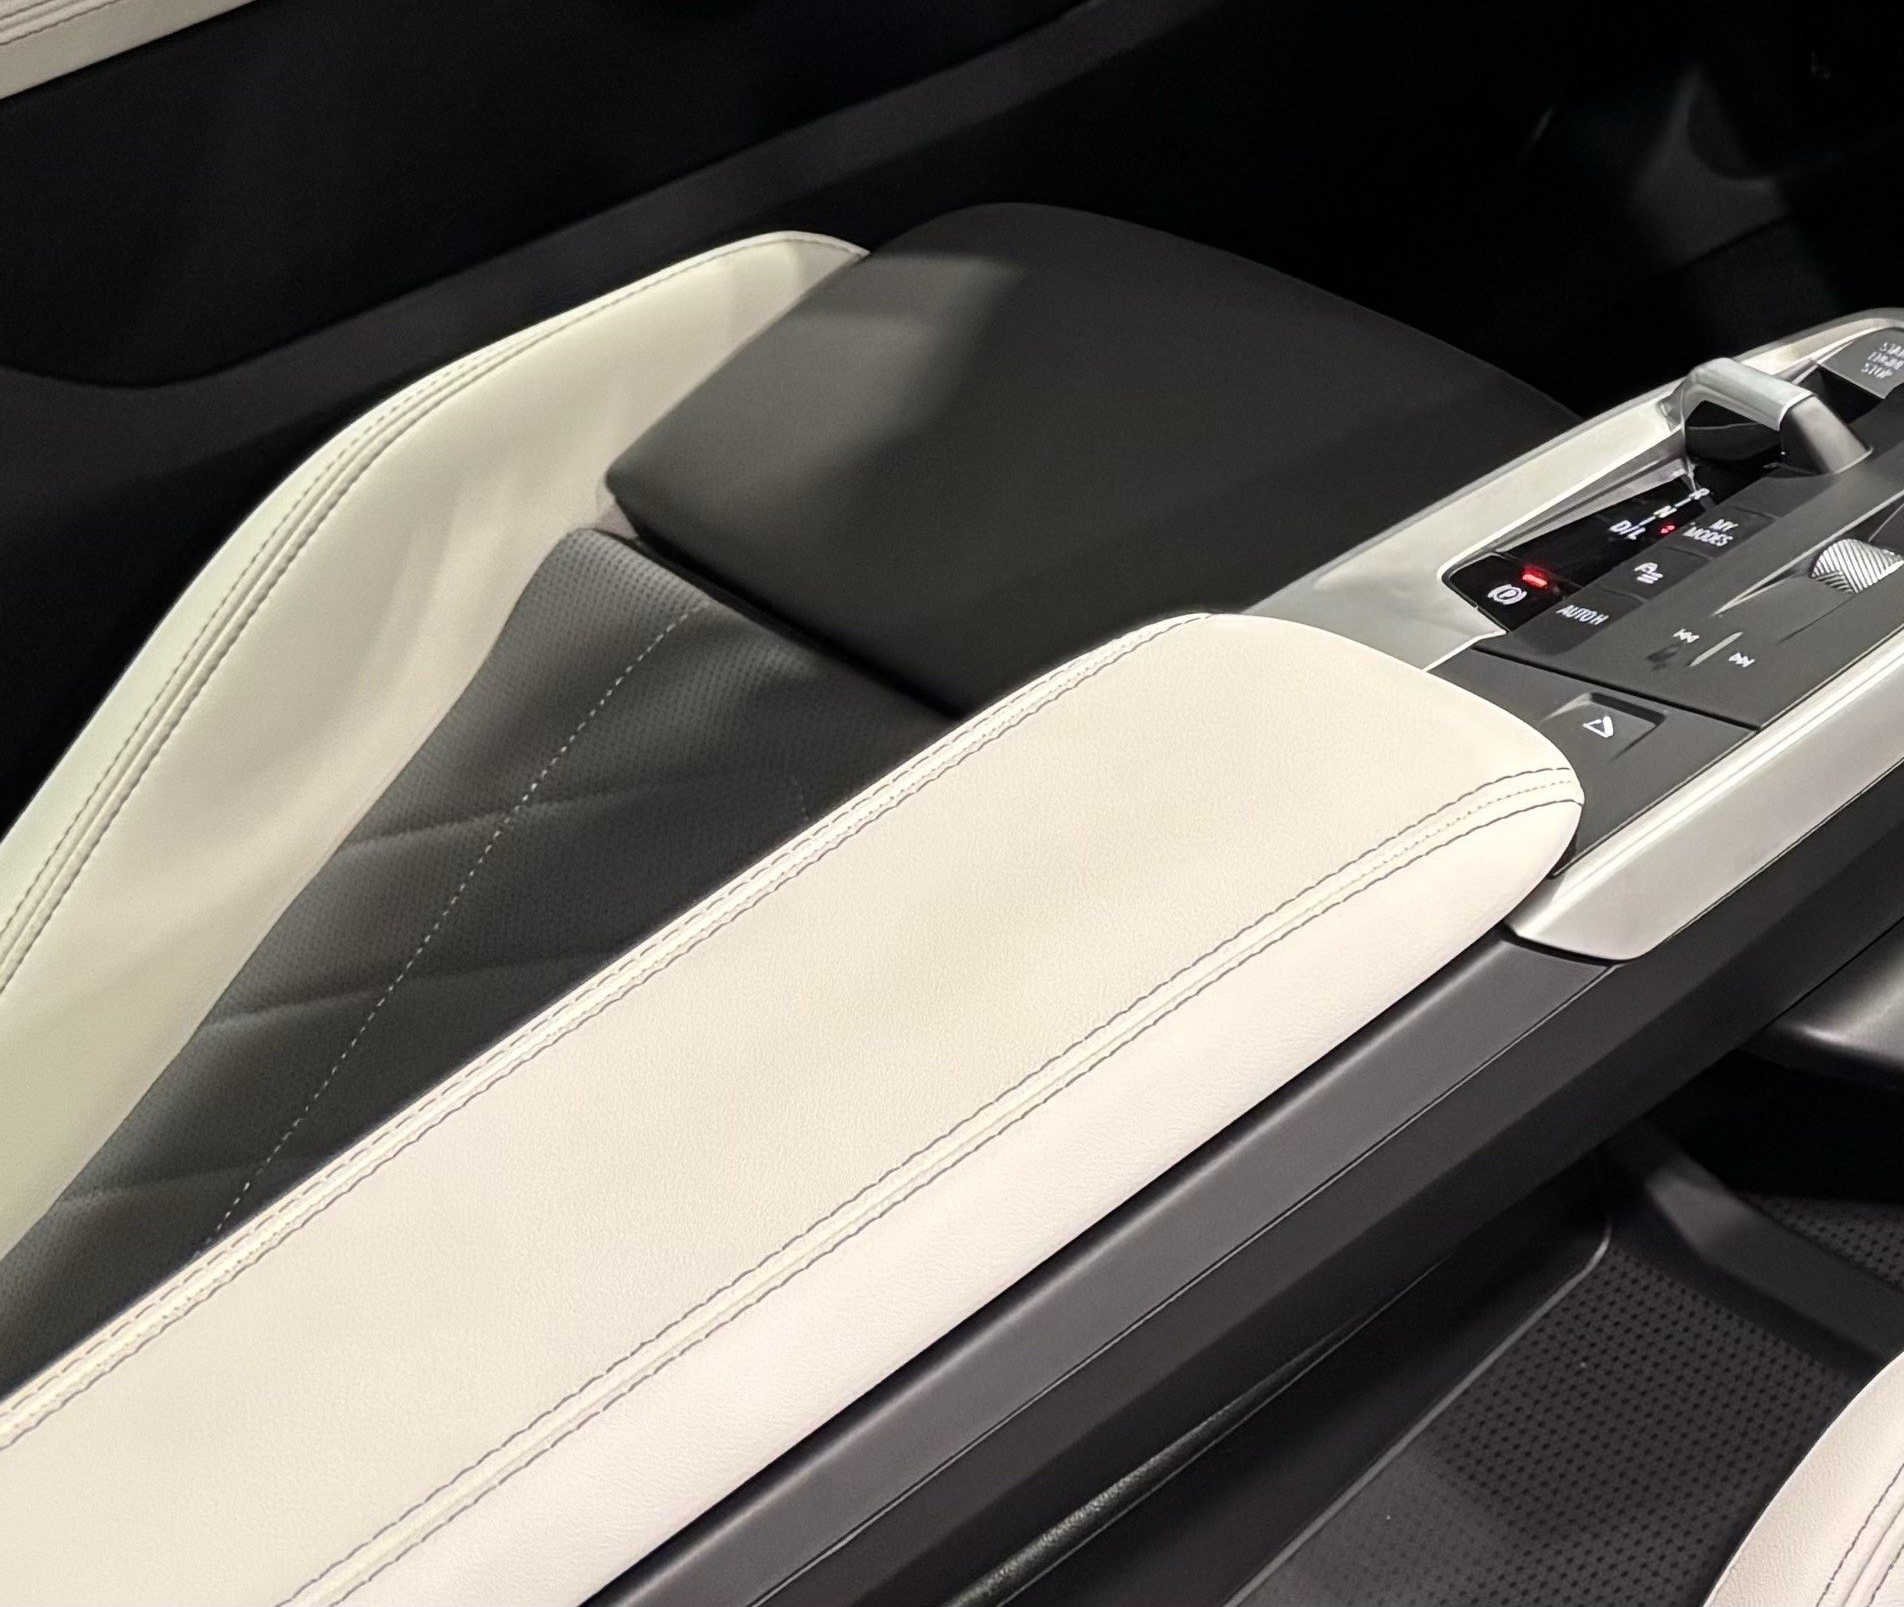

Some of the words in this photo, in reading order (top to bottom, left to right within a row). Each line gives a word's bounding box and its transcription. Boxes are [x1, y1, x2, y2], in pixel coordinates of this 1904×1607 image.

[1861, 362, 1893, 379] STOP
[1653, 505, 1677, 518] N
[1609, 520, 1646, 540] D/L
[1709, 518, 1739, 532] MY
[1682, 526, 1734, 547] MODES
[1556, 604, 1597, 623] AUTO
[1589, 613, 1609, 625] H
